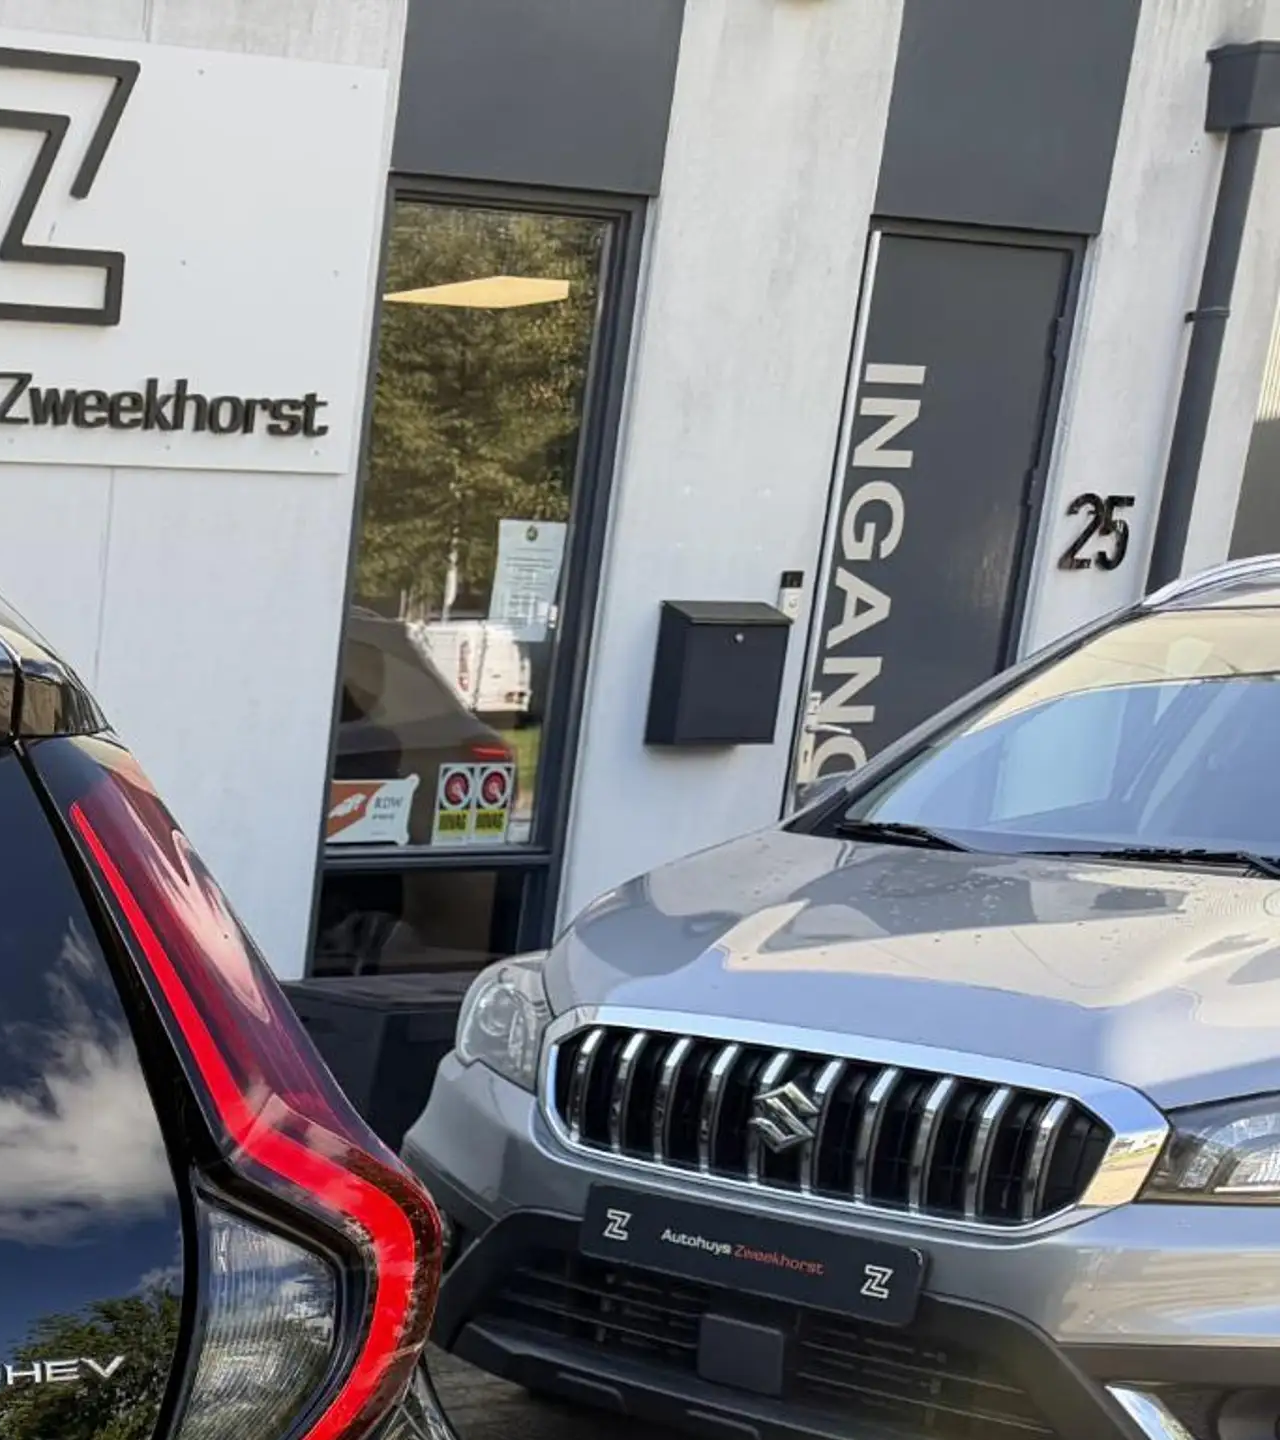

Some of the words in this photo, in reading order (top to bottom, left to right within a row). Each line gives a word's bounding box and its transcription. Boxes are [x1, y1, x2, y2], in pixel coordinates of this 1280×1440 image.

[1056, 492, 1136, 571] 25
[660, 1227, 733, 1255] Autohuys
[731, 1243, 825, 1276] Zweekhorst
[2, 1355, 126, 1385] HEV
